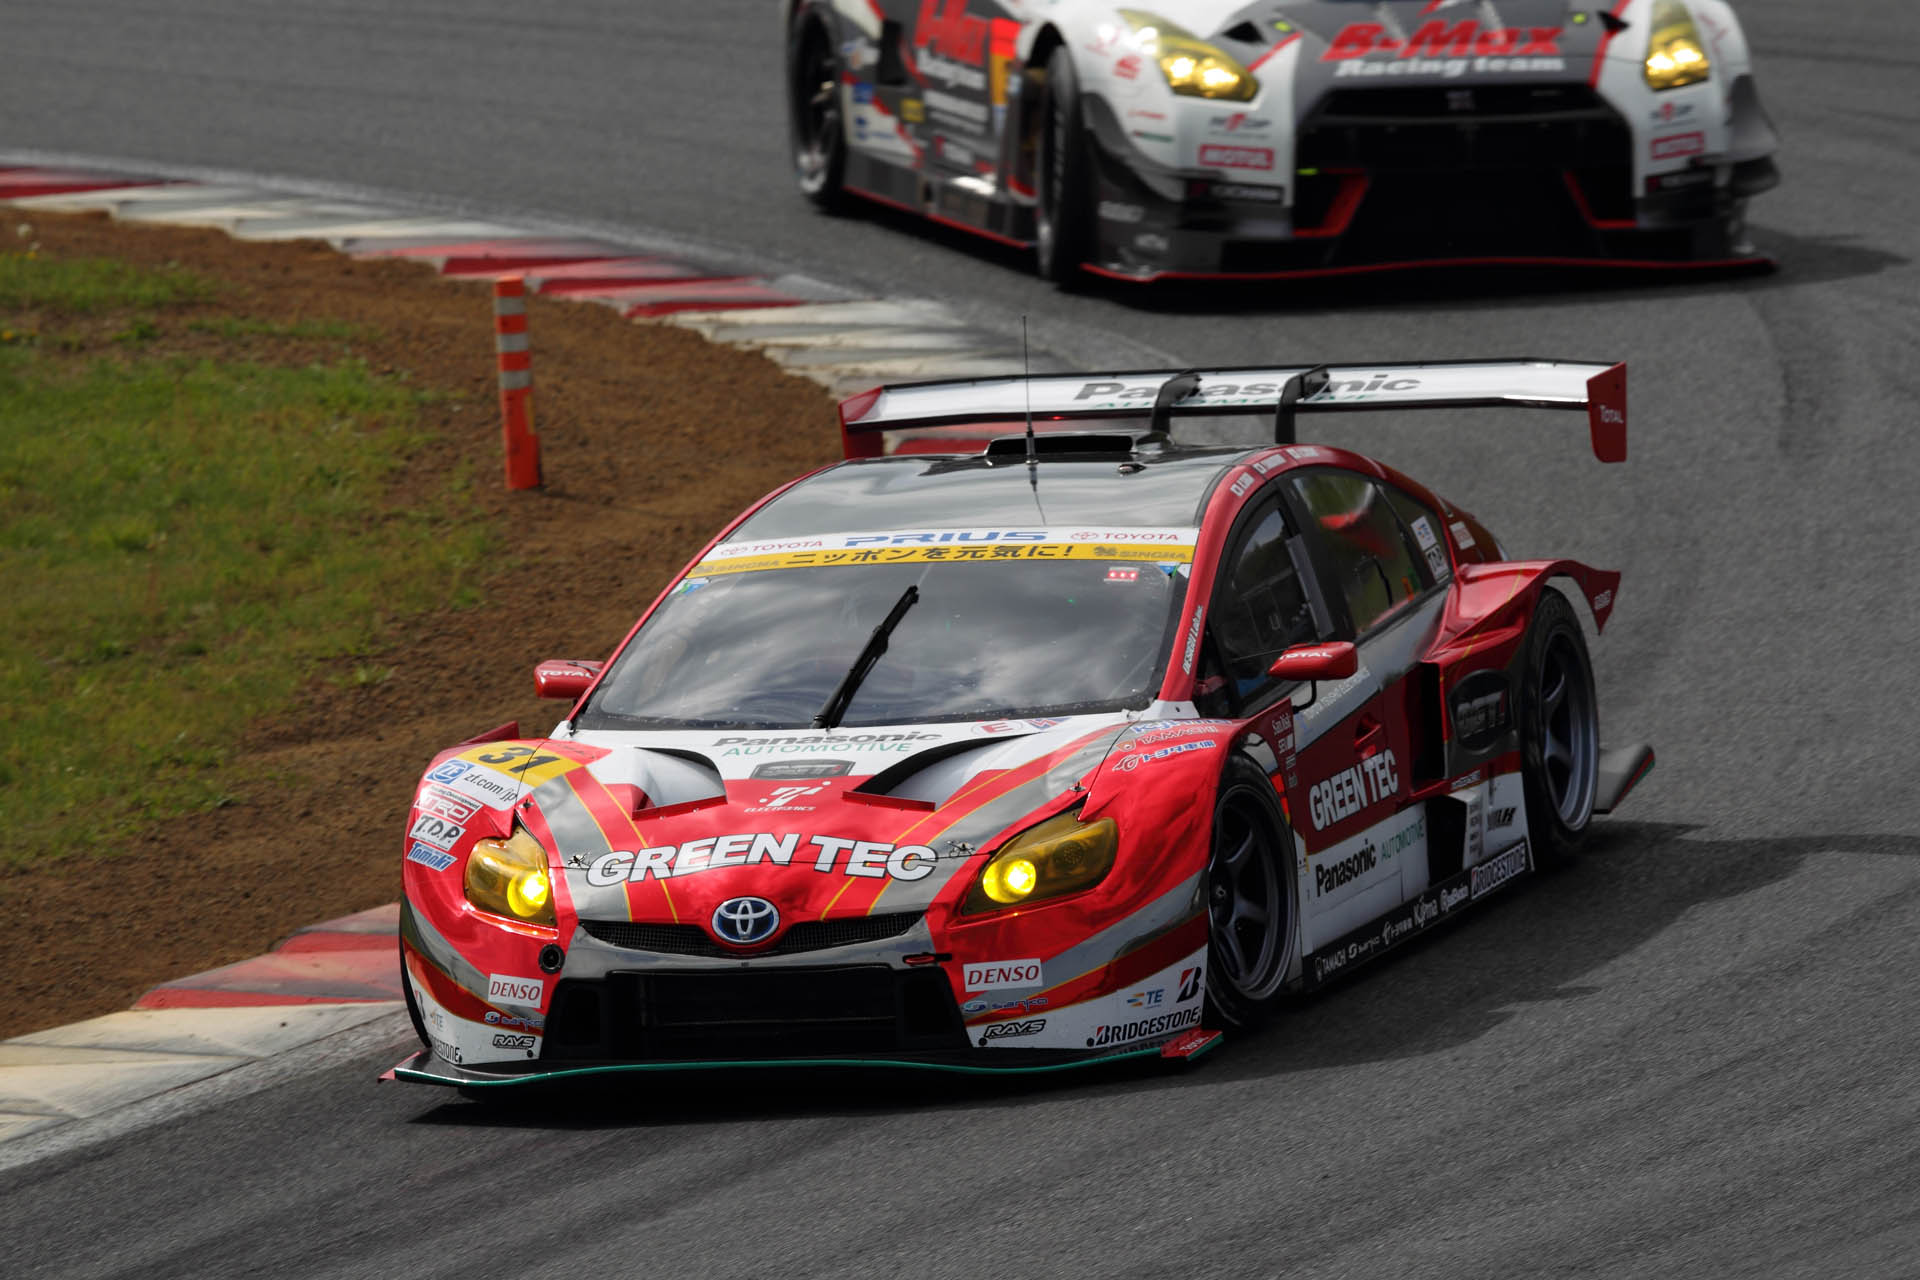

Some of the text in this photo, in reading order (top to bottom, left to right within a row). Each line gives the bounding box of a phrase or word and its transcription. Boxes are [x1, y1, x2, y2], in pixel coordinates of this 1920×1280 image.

[1320, 20, 1563, 61] B-Max
[1334, 55, 1564, 77] Racing team
[1073, 373, 1421, 400] Paasnic
[1600, 404, 1624, 424] TOTAL
[752, 539, 824, 552] TOYOTA
[845, 531, 1048, 547] PRIUS
[1103, 532, 1179, 541] TOYOTA
[1279, 649, 1333, 659] TOTAL
[711, 731, 942, 748] Panasonic
[722, 742, 914, 757] AUTOMOTIVE
[478, 746, 561, 774] 31
[463, 771, 518, 802] zf.com/jp
[1309, 749, 1399, 832] GREEN TEC
[744, 805, 816, 813] ELECTRONICS
[1381, 815, 1425, 861] AUTOMOTIVE
[586, 833, 940, 888] GREEN TEC
[1315, 838, 1377, 898] Panasonic
[967, 965, 1040, 986] DENSO
[490, 980, 541, 1001] DENSO
[1146, 988, 1165, 1004] TE
[983, 1018, 1047, 1038] RAYS
[1095, 1006, 1202, 1047] BRIDGESTONE
[492, 1034, 536, 1048] RAYS
